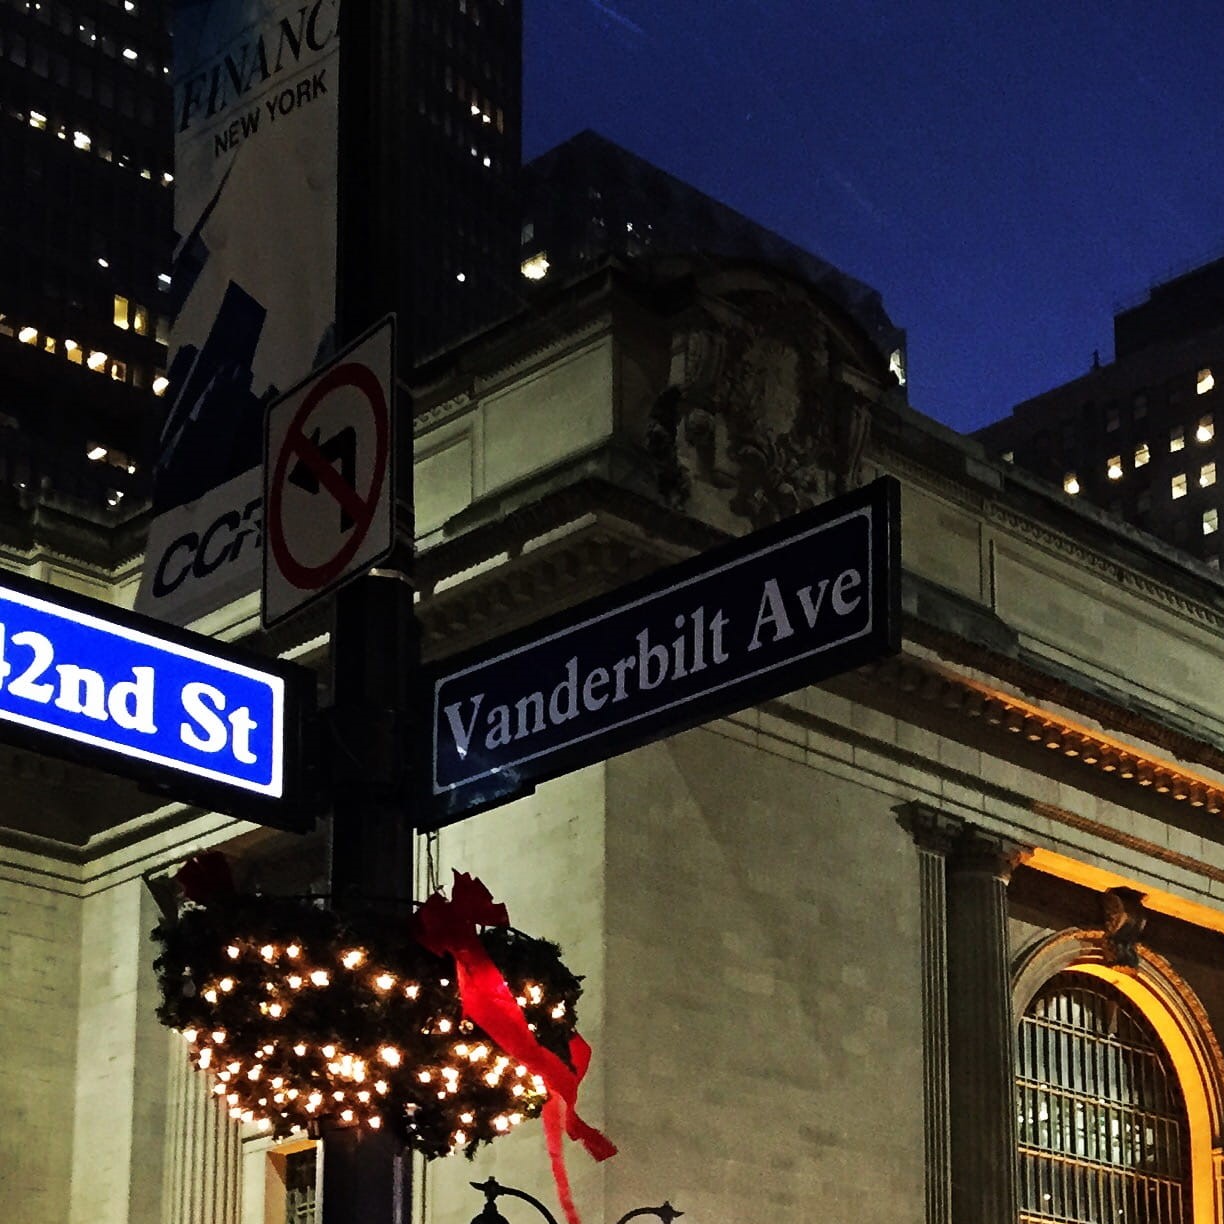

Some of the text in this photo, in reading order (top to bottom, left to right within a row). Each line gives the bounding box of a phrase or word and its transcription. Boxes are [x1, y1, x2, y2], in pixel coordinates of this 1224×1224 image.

[179, 0, 341, 132] FINANC
[214, 69, 328, 157] NEW YORK
[0, 622, 258, 765] 2nd St
[444, 568, 862, 760] Vanderbilt Ave
